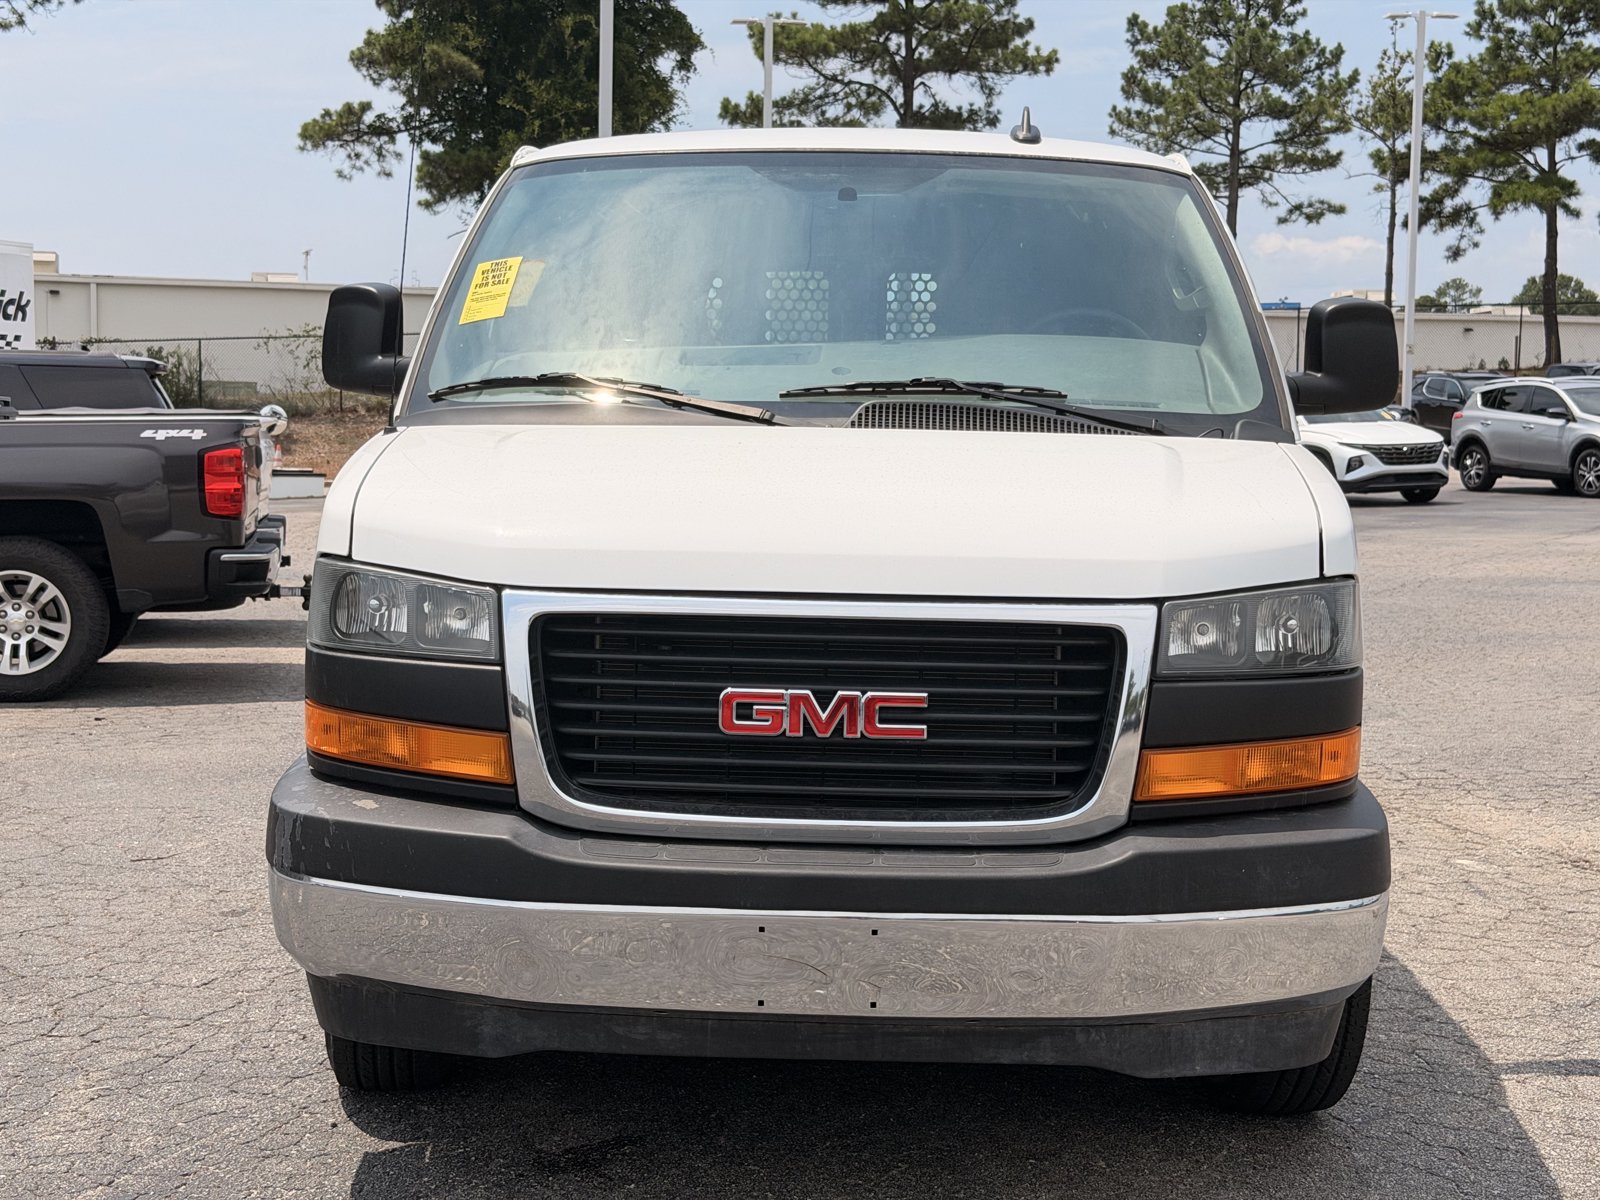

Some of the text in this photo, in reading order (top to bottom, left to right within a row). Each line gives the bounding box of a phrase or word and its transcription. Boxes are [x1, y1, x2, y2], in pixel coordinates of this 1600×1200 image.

[490, 260, 508, 269] THIS
[481, 265, 513, 276] VEHICLE
[491, 278, 510, 287] SALE
[719, 687, 928, 739] GMC
